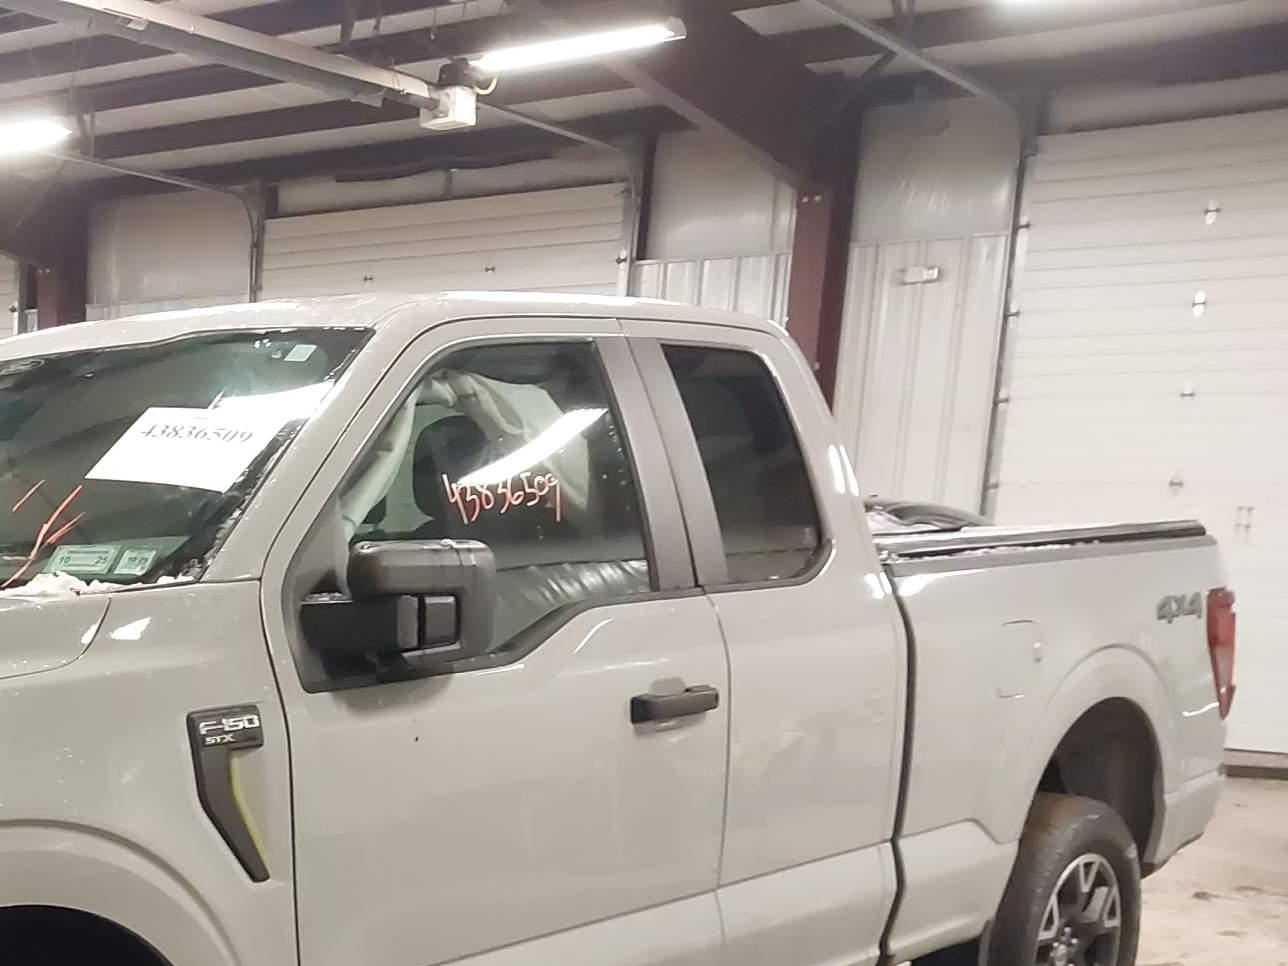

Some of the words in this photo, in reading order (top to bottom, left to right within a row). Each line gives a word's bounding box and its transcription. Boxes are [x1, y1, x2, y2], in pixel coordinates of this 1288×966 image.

[141, 424, 253, 442] 43836509
[441, 471, 561, 524] 43836509
[199, 714, 260, 735] F-150
[205, 734, 235, 745] STX
